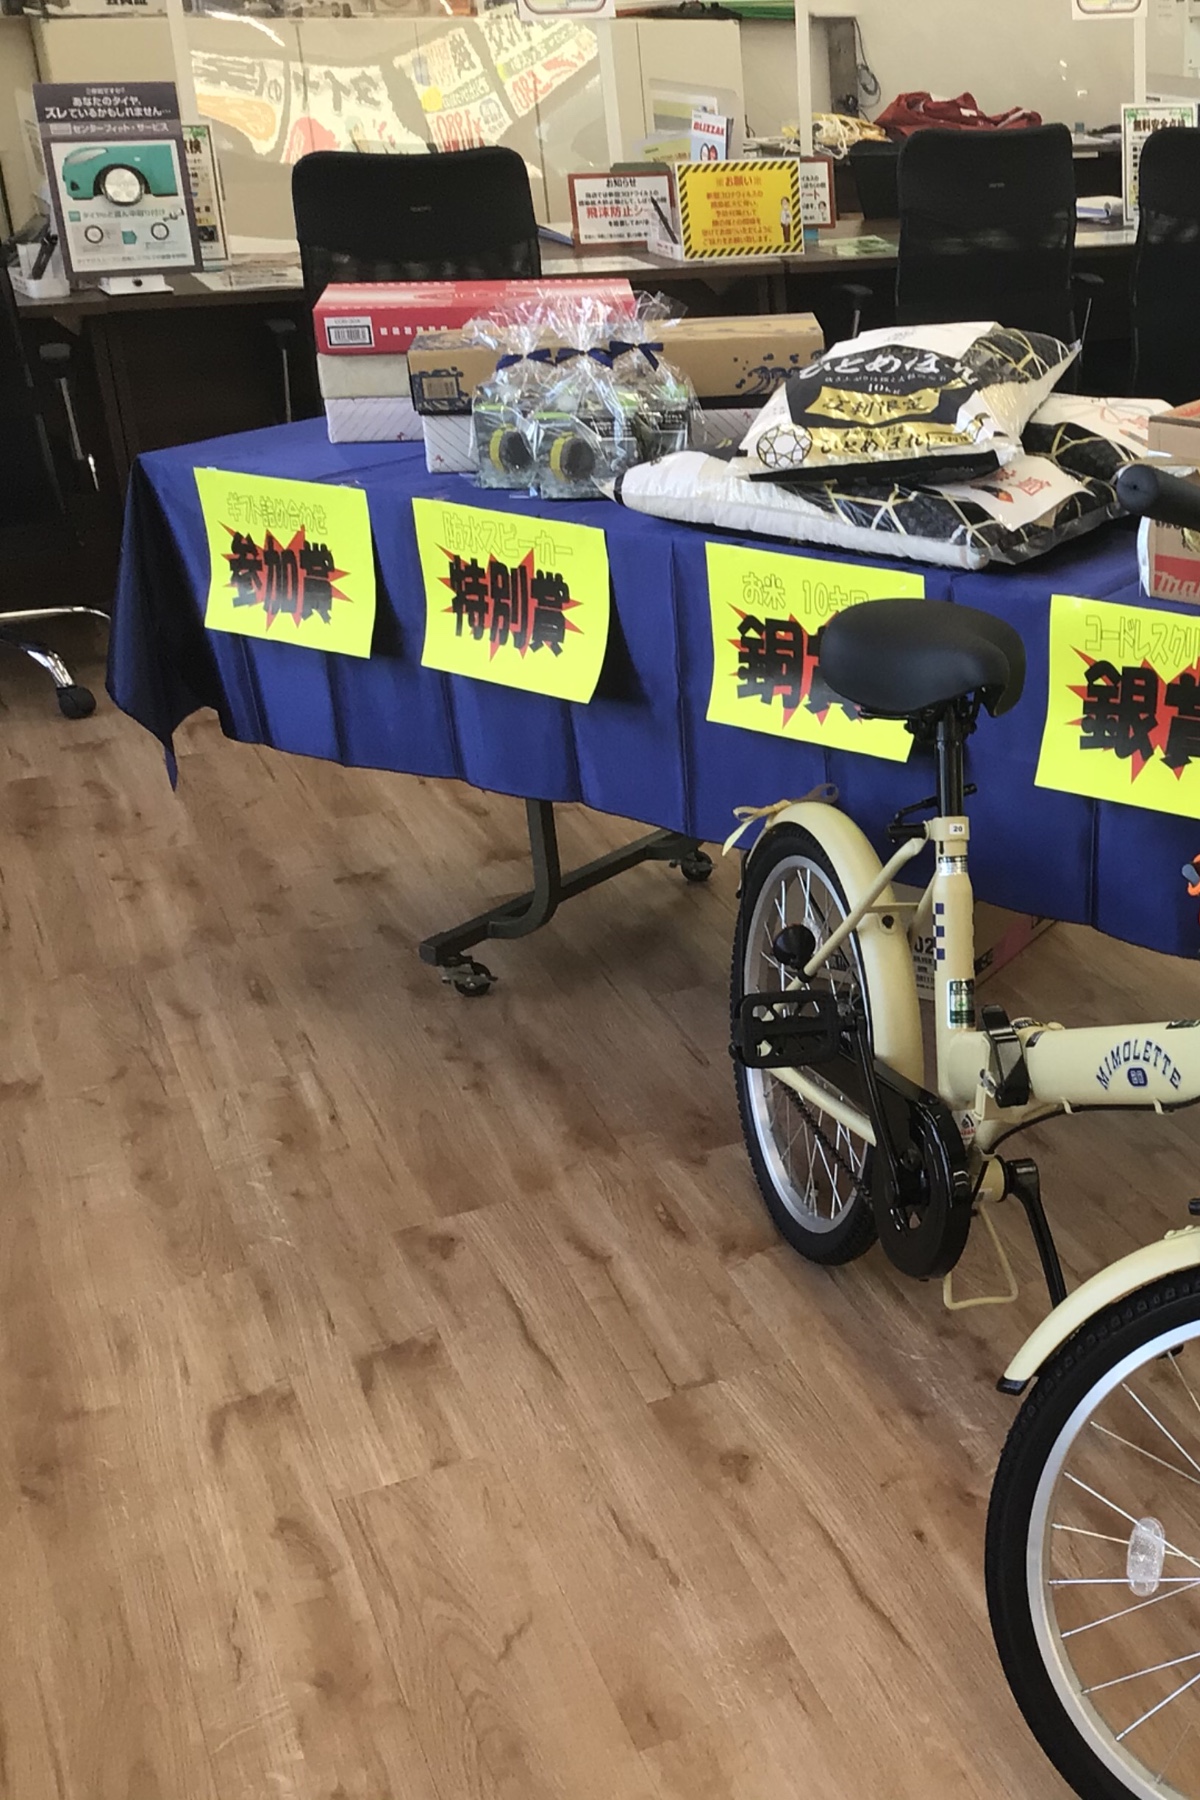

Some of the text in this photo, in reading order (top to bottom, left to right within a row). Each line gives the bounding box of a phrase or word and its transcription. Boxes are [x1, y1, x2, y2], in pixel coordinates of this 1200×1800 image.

[227, 491, 329, 535] ギフト詰め合わせ
[442, 510, 573, 567] 防水スピーカー
[229, 531, 335, 625] 参加賞
[742, 571, 786, 611] お米
[449, 554, 570, 658] 特別賞
[953, 825, 963, 833] 20
[1096, 1038, 1182, 1091] MIMOLETTE
